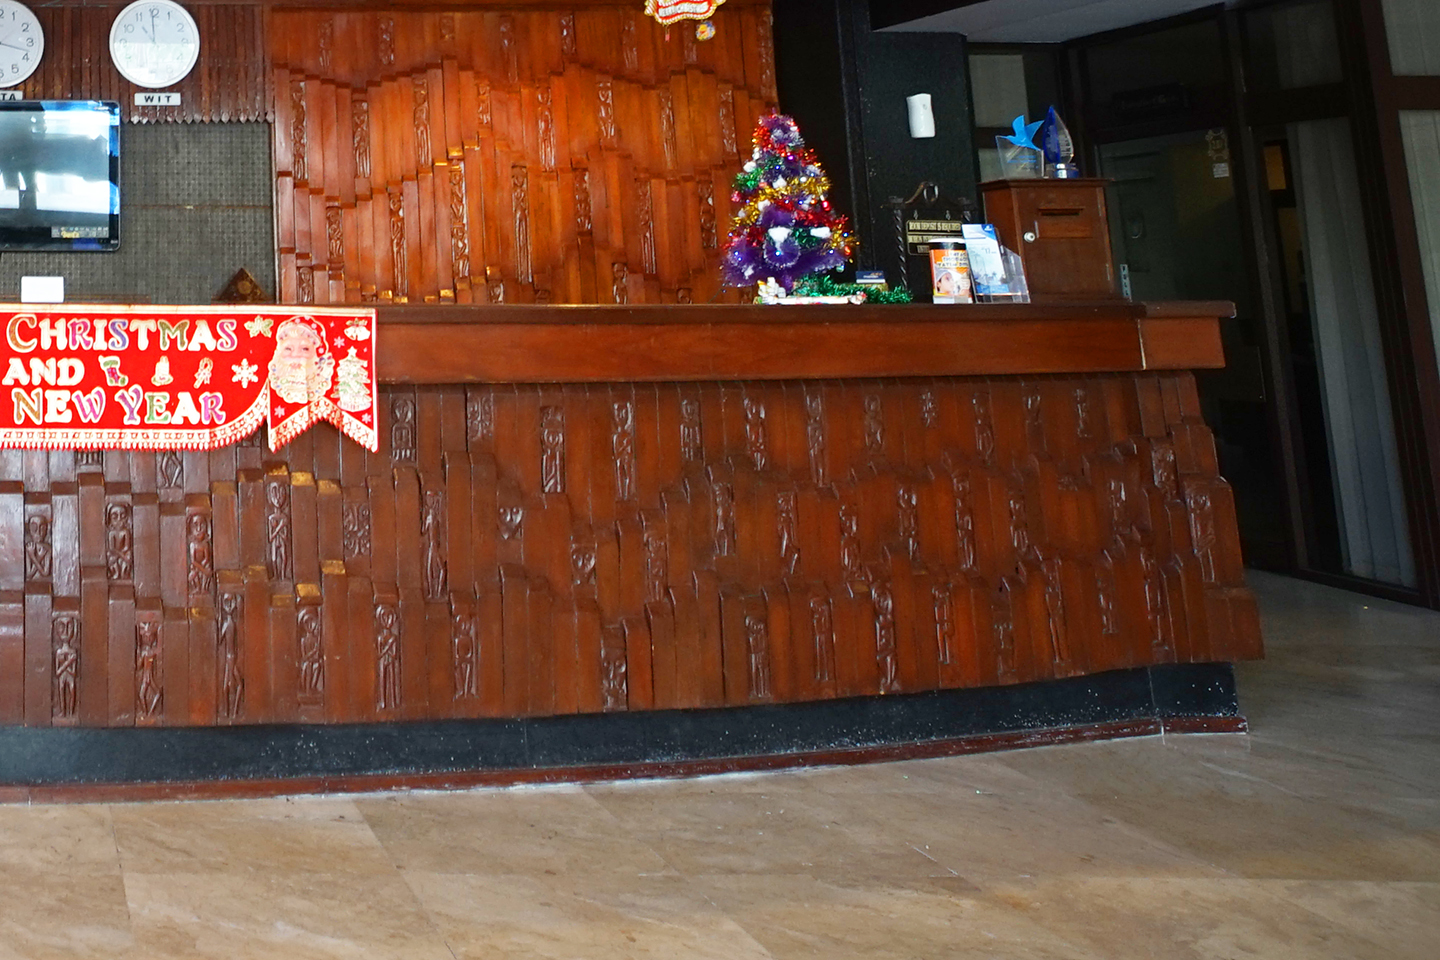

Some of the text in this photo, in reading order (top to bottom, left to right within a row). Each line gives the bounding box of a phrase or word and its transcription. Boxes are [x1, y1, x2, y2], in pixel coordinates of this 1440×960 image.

[12, 11, 16, 21] 1
[167, 11, 171, 20] 1
[21, 22, 30, 32] 2
[123, 24, 135, 34] 10
[176, 22, 184, 32] 2
[26, 37, 34, 48] 3
[22, 52, 30, 62] 4
[11, 64, 20, 74] 5
[144, 95, 172, 103] WIT
[6, 313, 238, 353] CHRISTMAS
[1, 356, 86, 386] AND
[11, 386, 107, 425] NEW
[115, 384, 227, 425] YEAR
